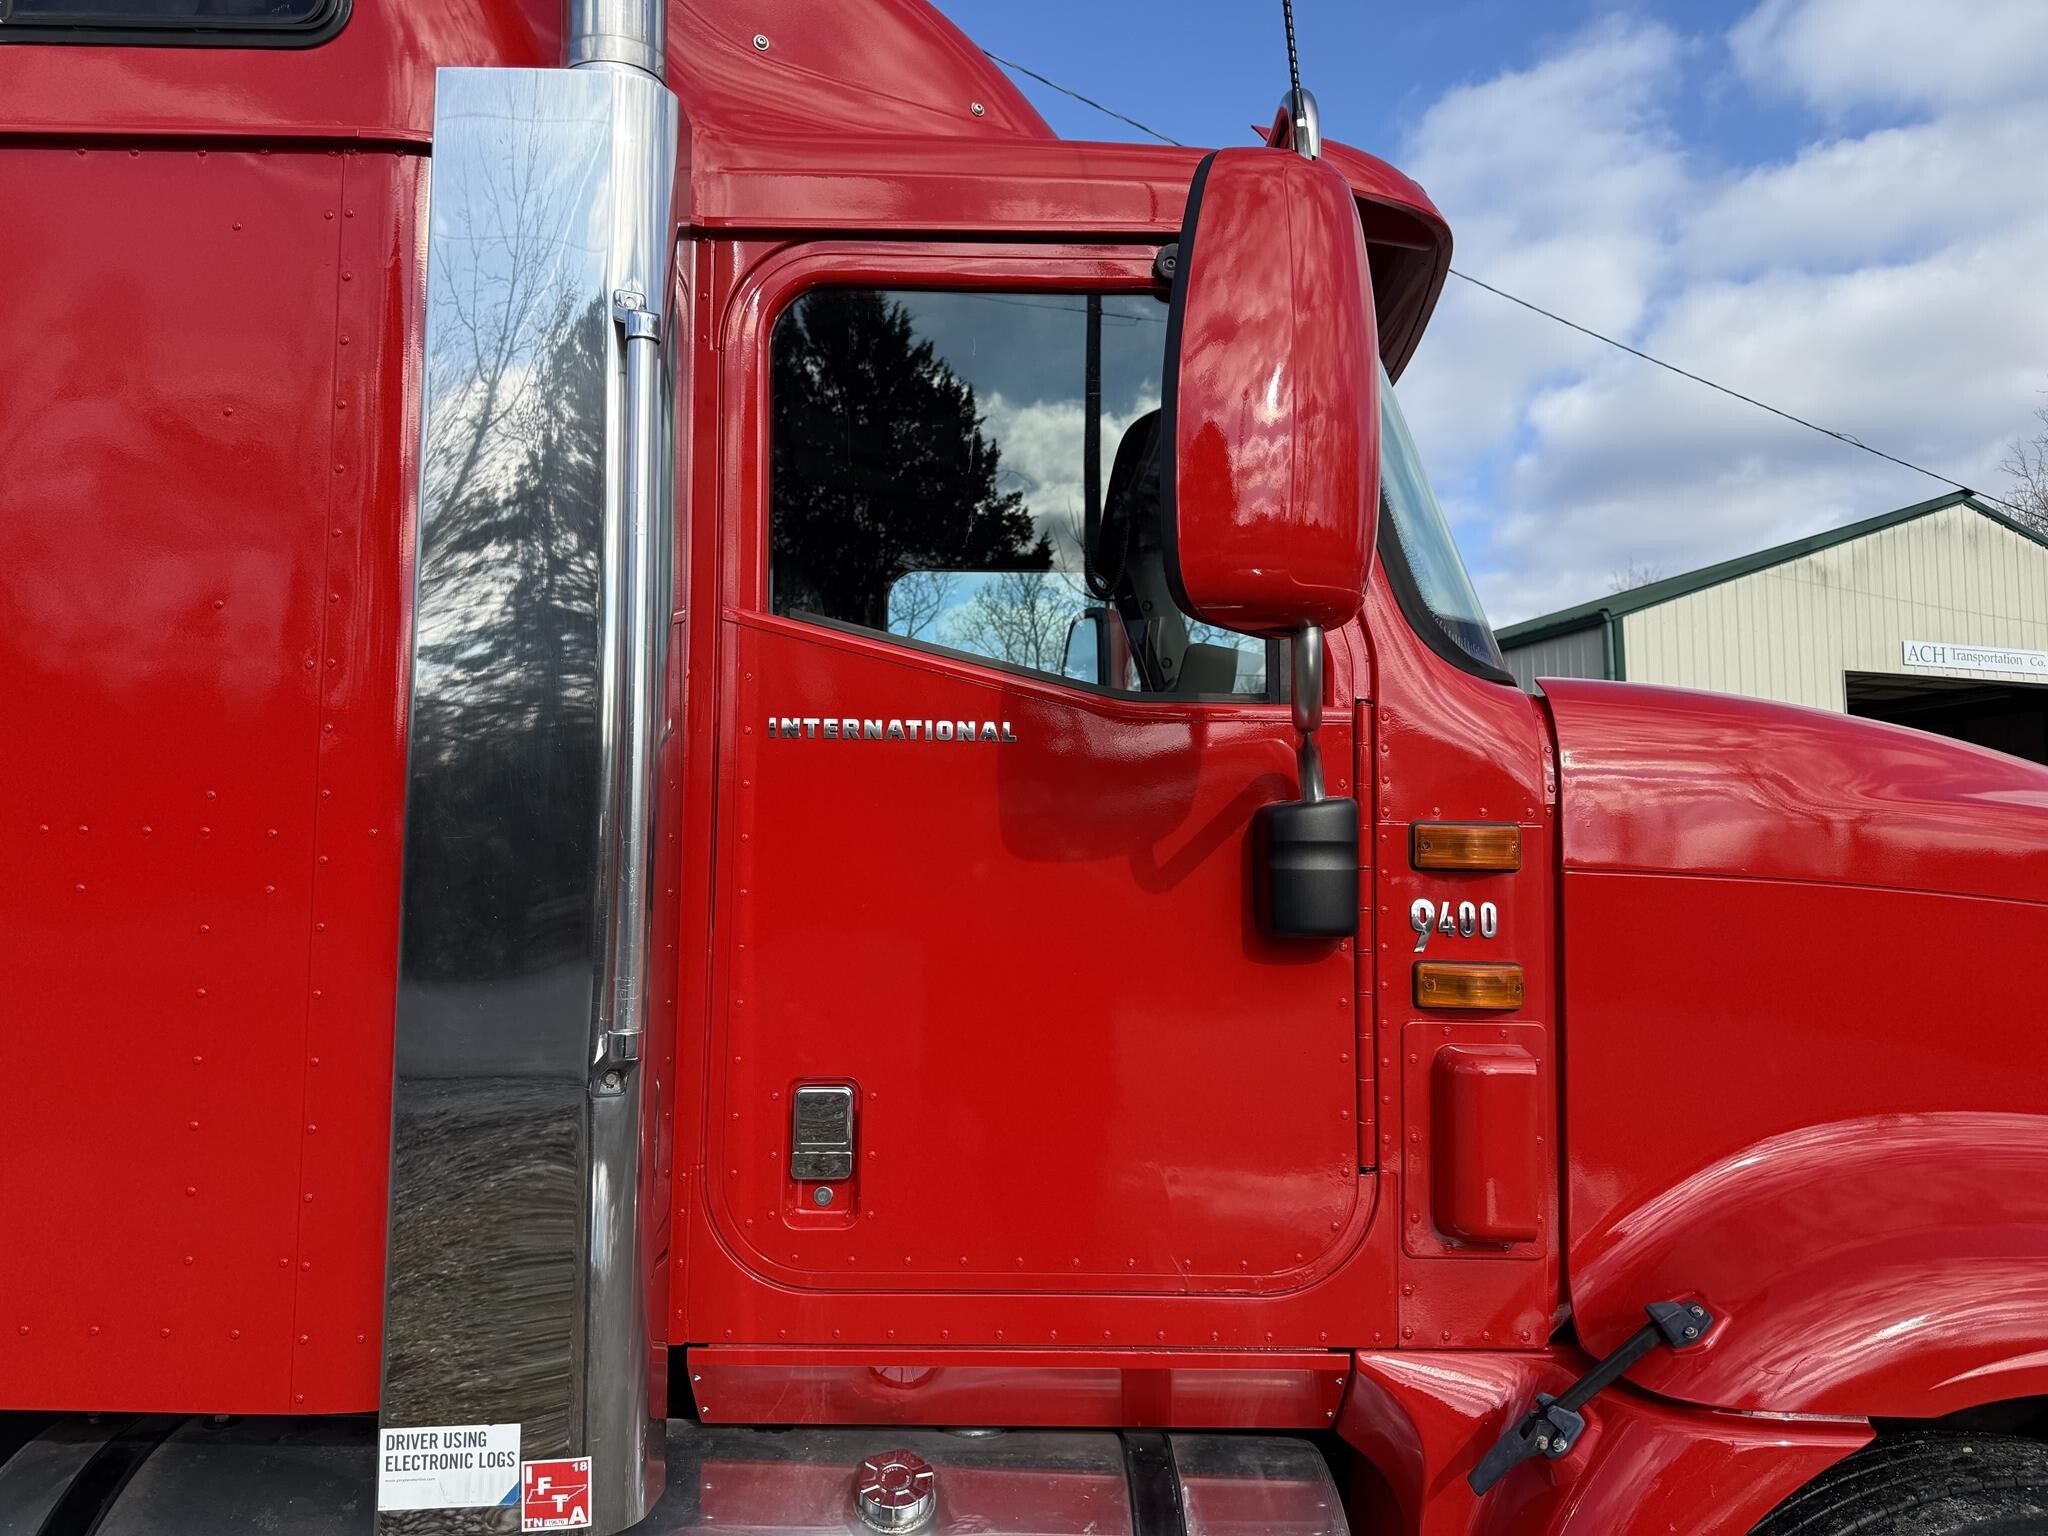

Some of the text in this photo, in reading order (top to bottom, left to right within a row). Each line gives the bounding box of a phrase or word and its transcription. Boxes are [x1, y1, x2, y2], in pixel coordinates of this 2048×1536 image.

[1907, 644, 2046, 667] ACH Transportation Co.
[768, 717, 1017, 743] INTERNATIONAL
[1410, 898, 1497, 953] 9400
[386, 1431, 487, 1451] DRIVER USING
[385, 1451, 515, 1472] ELECTRONIC LOGS
[572, 1461, 588, 1472] 18
[525, 1518, 543, 1528] TN
